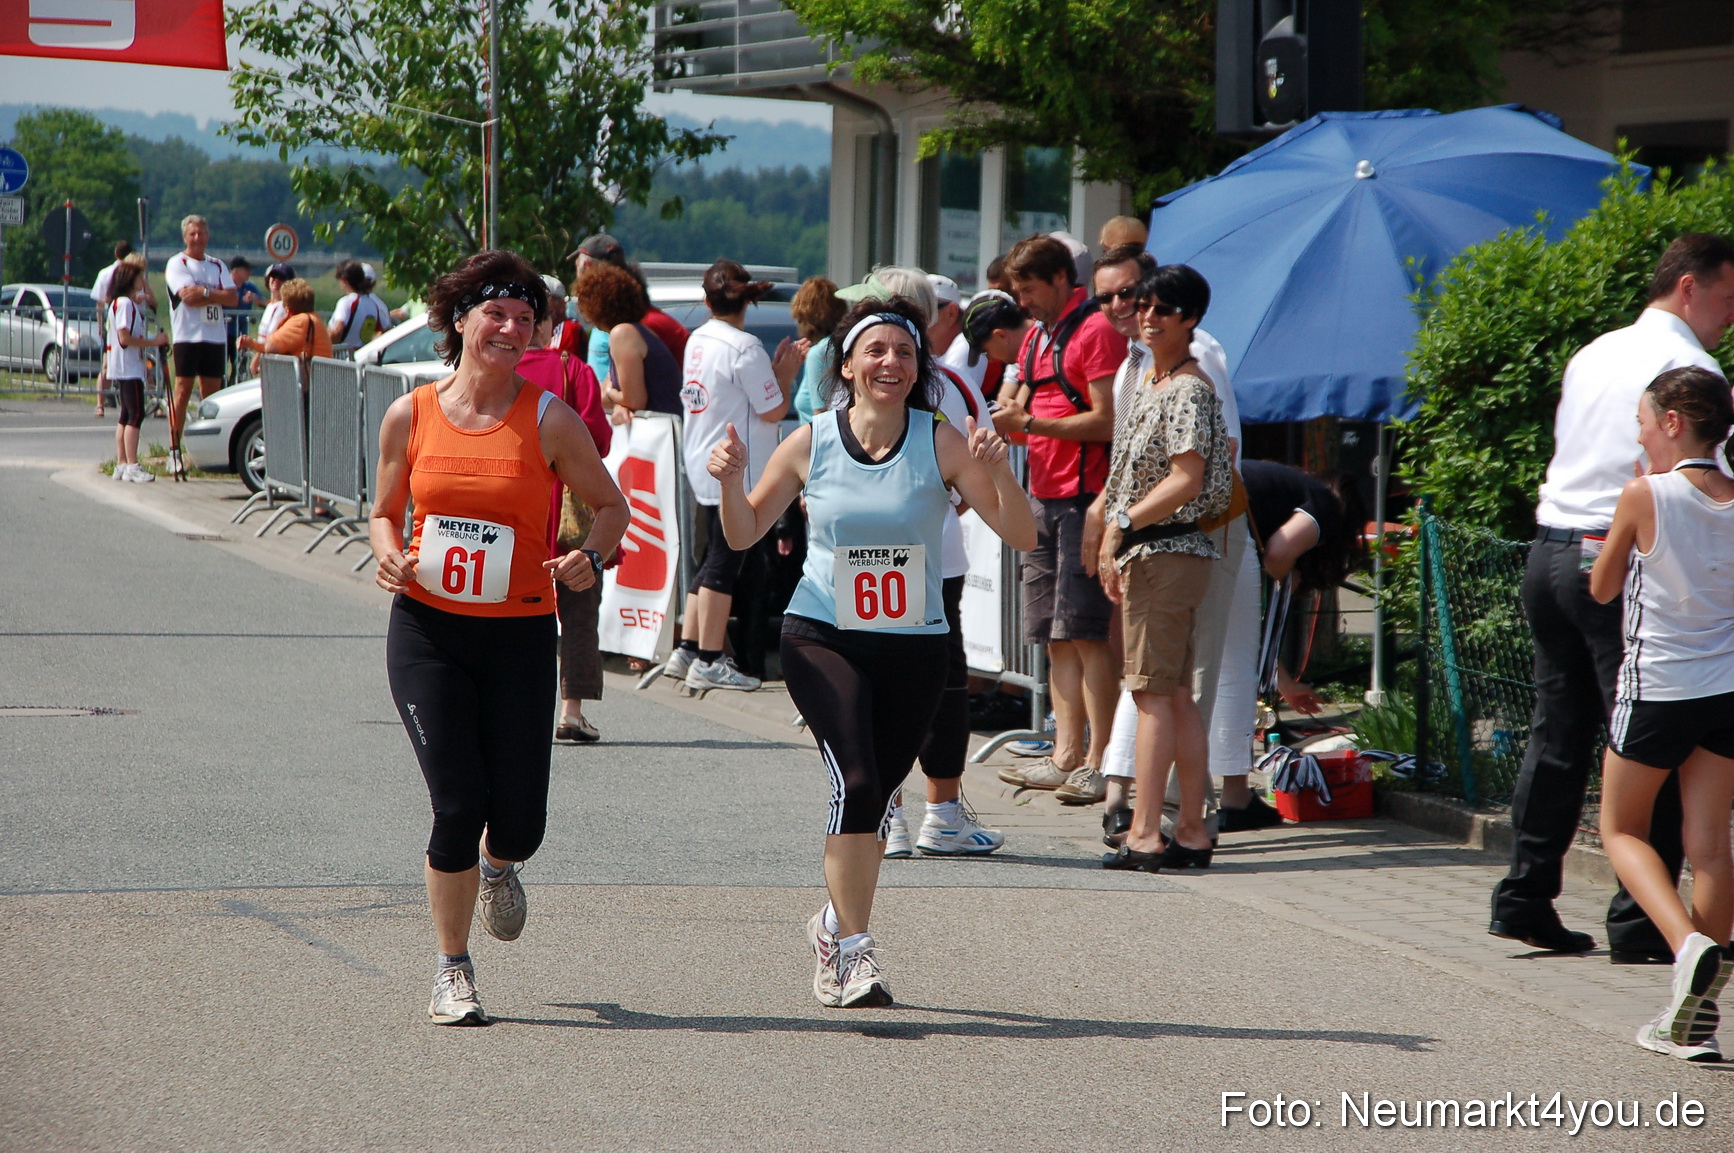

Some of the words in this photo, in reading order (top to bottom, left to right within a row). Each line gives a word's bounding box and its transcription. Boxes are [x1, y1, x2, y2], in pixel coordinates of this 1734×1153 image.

[273, 234, 292, 251] 60
[206, 305, 219, 321] 50
[438, 519, 480, 534] MEYER
[437, 529, 480, 541] WERBUNG
[848, 549, 890, 559] MEYER
[848, 558, 891, 567] WERBUNG
[441, 546, 487, 597] 61
[854, 571, 907, 620] 60
